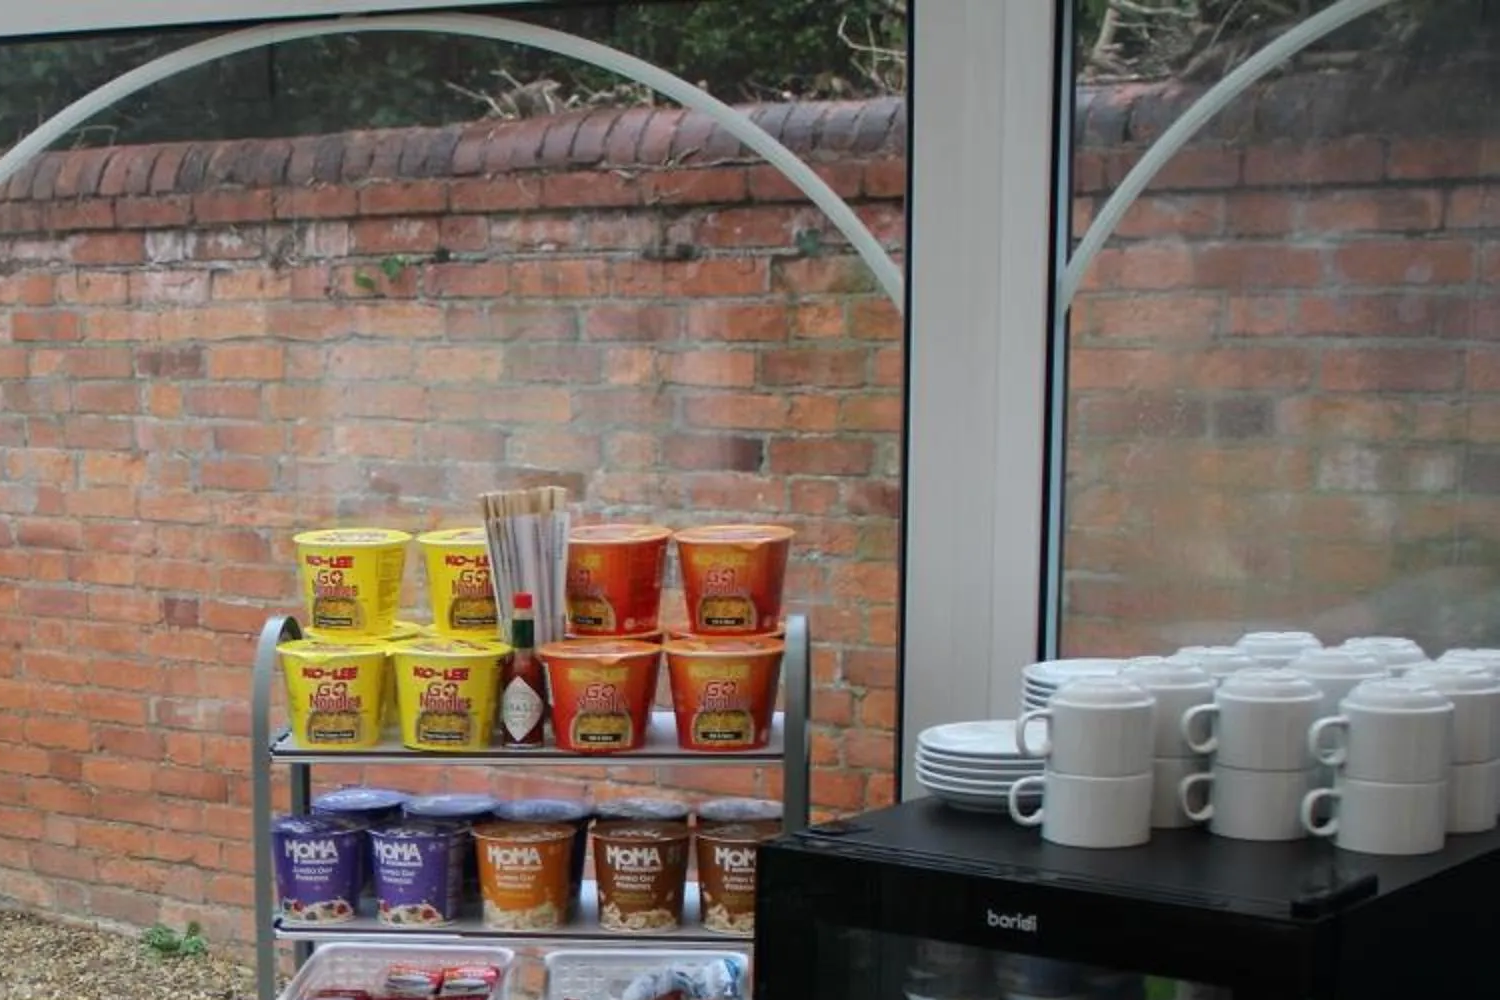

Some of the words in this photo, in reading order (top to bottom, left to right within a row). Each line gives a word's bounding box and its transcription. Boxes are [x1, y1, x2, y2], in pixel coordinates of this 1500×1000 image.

[302, 667, 359, 680] KO-LEE
[285, 839, 339, 865] MOMA
[373, 838, 423, 865] MOMA
[487, 844, 542, 870] MOMA
[606, 845, 662, 871] MOMA
[714, 846, 757, 871] MOM
[986, 908, 1037, 933] baridi
